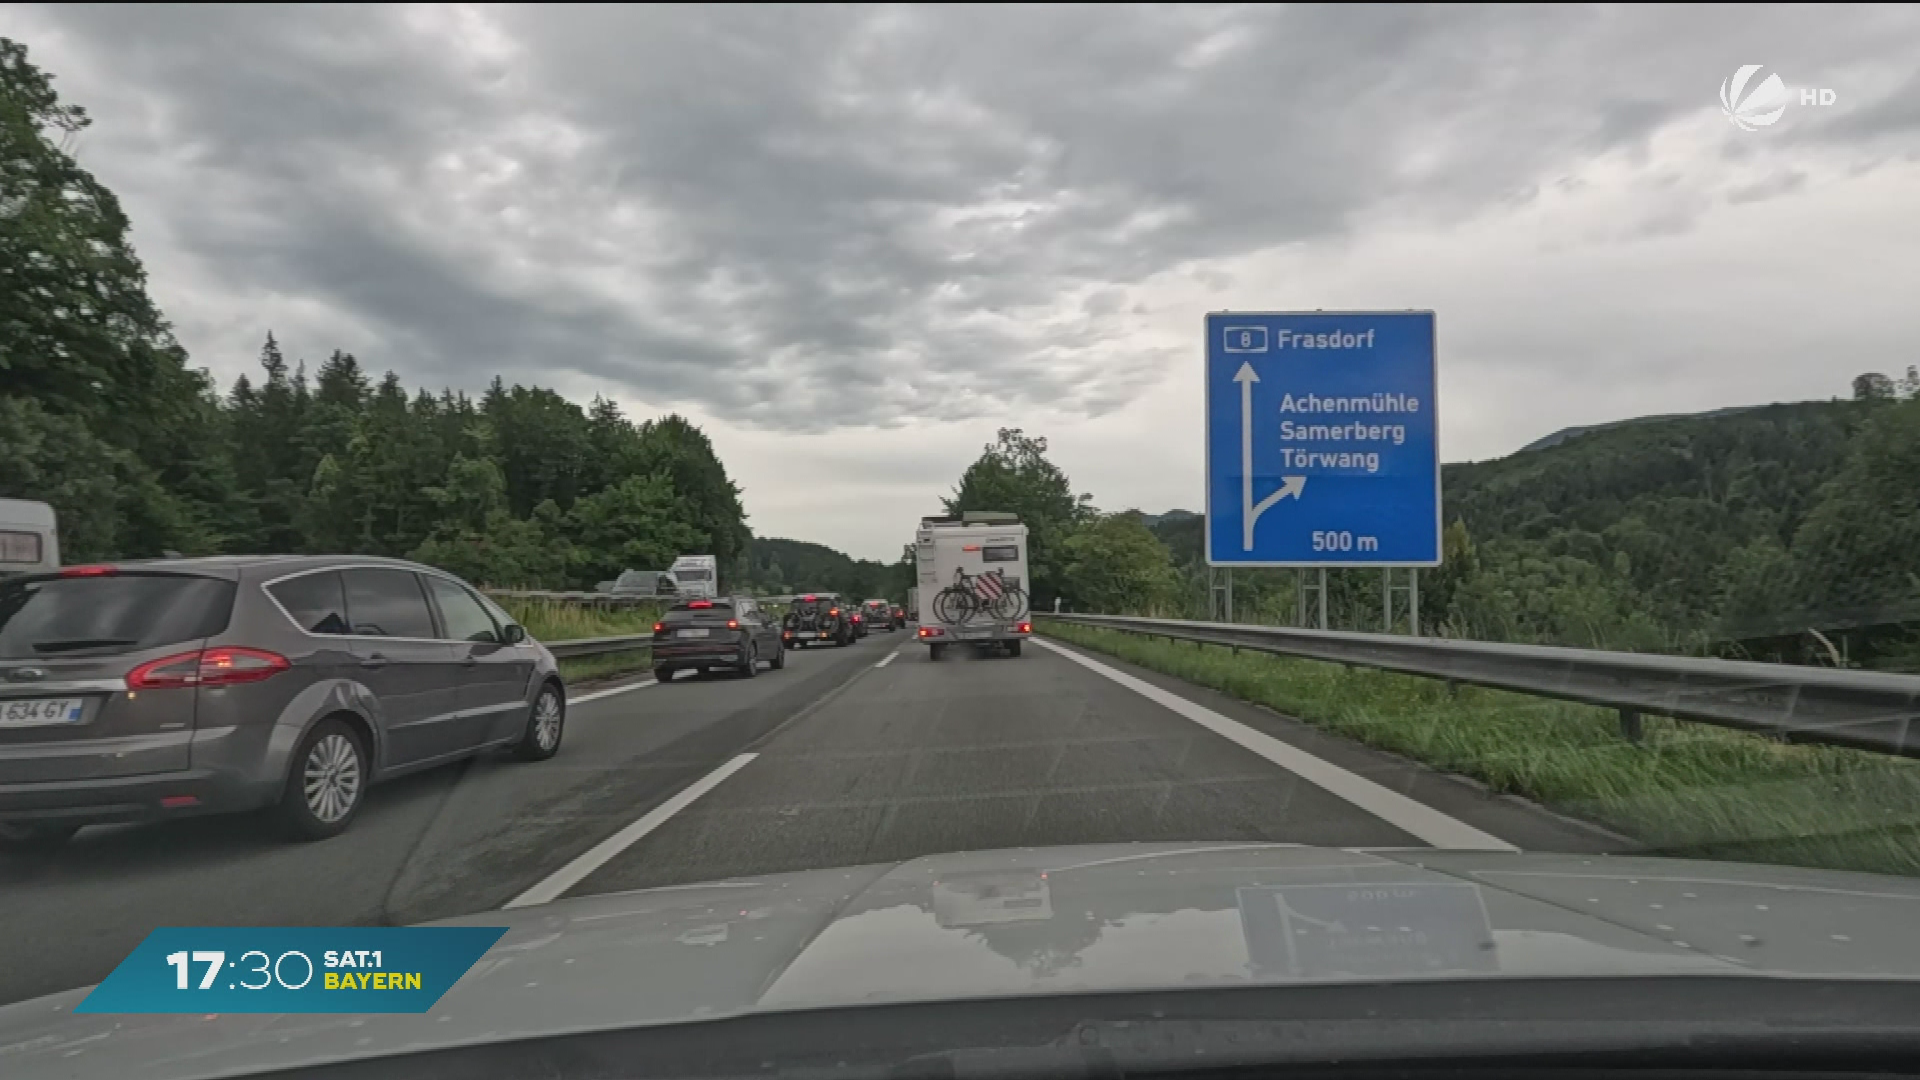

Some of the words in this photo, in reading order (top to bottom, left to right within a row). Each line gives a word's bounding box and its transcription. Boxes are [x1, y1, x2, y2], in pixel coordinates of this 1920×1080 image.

[1240, 331, 1251, 348] 8
[1278, 329, 1375, 348] Frasdorf
[1280, 393, 1419, 413] Achenmühle
[1280, 421, 1405, 445] Samerberg
[1280, 449, 1379, 473] Törwang
[1312, 531, 1352, 551] 500
[1357, 536, 1378, 551] m
[7, 702, 39, 720] 634
